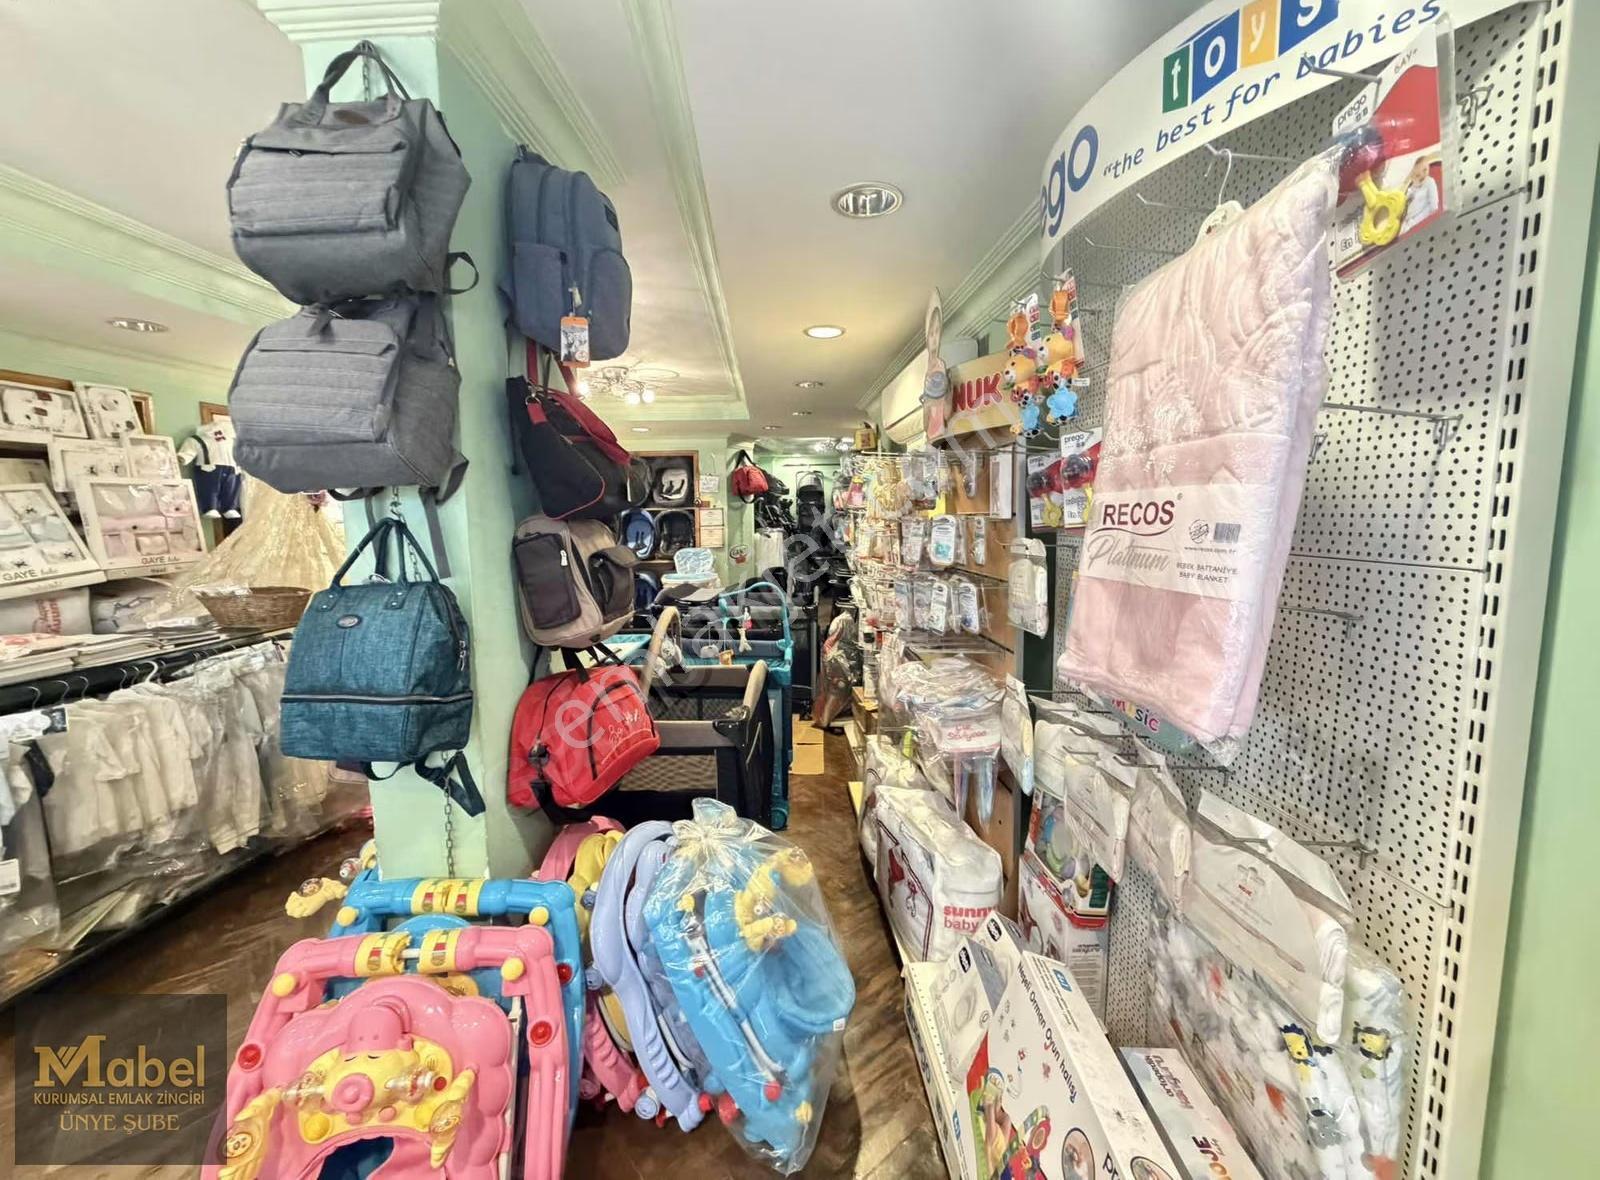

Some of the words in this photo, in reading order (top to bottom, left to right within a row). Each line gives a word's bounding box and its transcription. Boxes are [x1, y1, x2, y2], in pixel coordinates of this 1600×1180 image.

[1155, 104, 1215, 152] best
[1222, 72, 1280, 122] for
[1296, 0, 1440, 80] babies
[1337, 94, 1368, 128] prego
[952, 372, 1003, 412] NUK
[1102, 499, 1175, 526] RECOS
[1088, 533, 1171, 572] Platinum
[1197, 573, 1229, 583] BLANKET
[944, 917, 979, 933] baby
[1029, 991, 1047, 1030] Orman
[1044, 1028, 1061, 1062] Oyun
